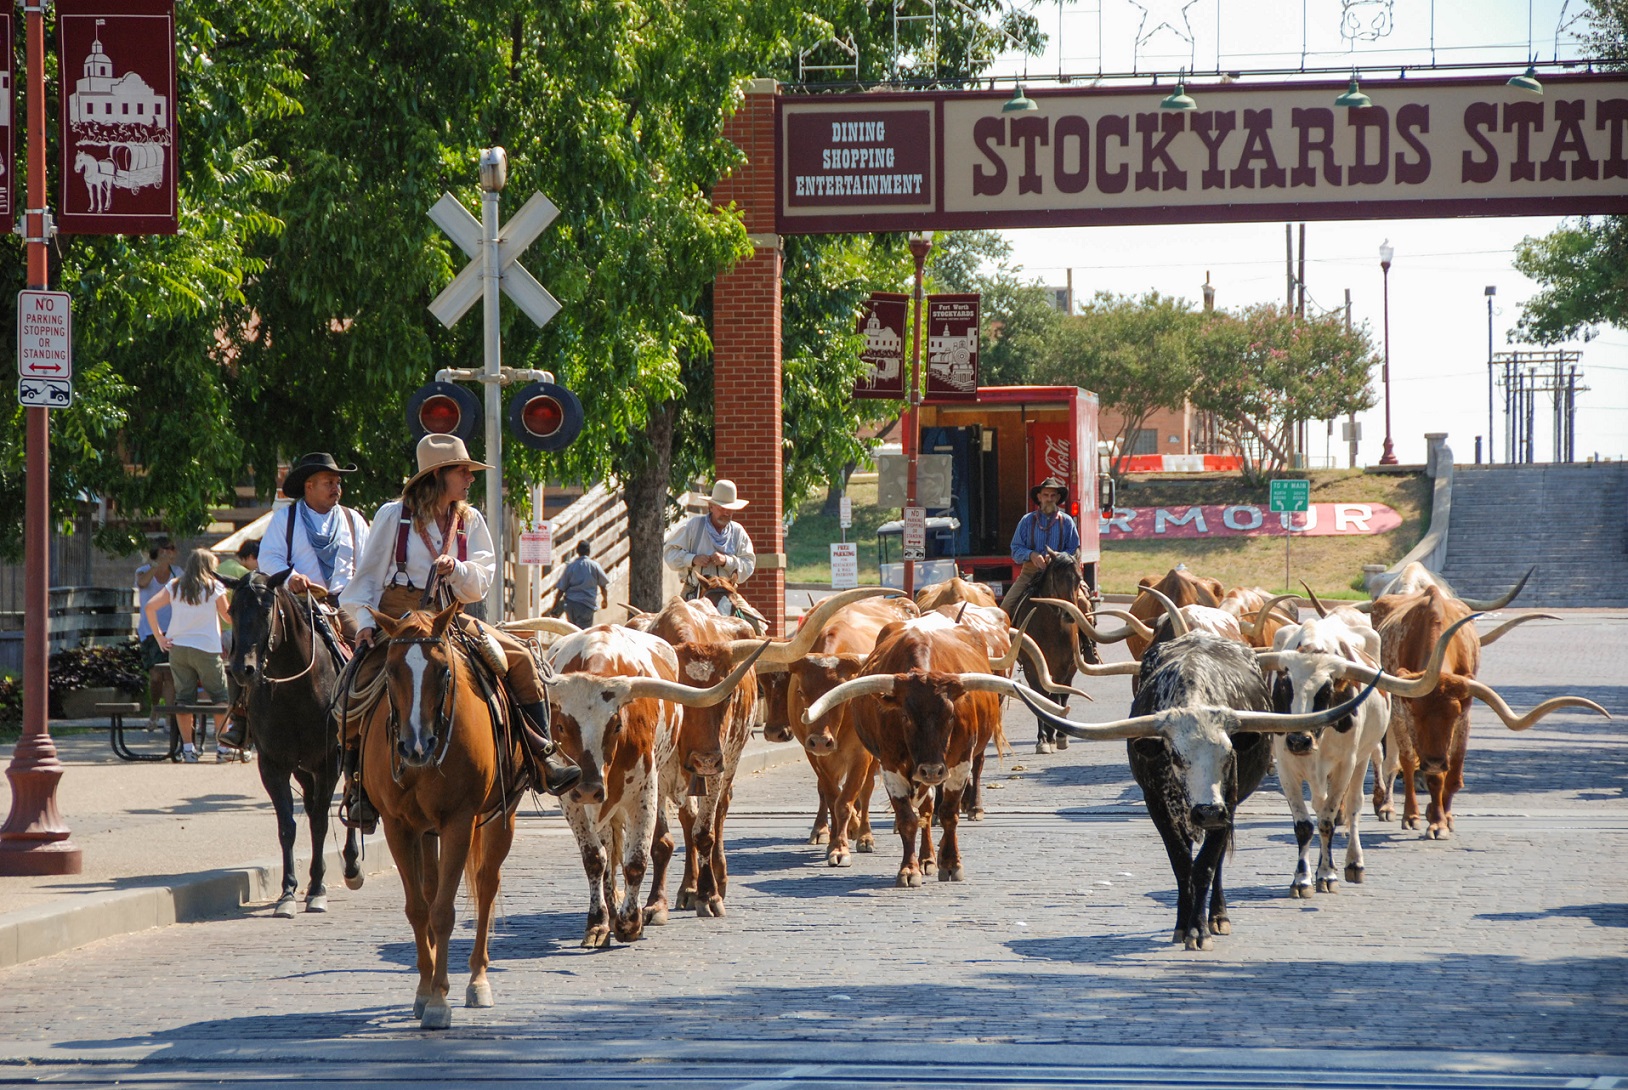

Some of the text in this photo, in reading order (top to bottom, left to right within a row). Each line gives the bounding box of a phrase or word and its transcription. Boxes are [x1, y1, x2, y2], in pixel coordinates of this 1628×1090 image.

[831, 121, 885, 143] DINING
[971, 97, 1628, 196] STOCKYARDS STAT
[822, 147, 895, 169] SHOPPING
[795, 173, 923, 196] ENTERTAINMENT
[35, 298, 54, 312] NO
[26, 313, 63, 325] PARKING
[23, 325, 65, 337] STOPPING
[38, 338, 51, 348] OR
[23, 348, 66, 360] STANDING
